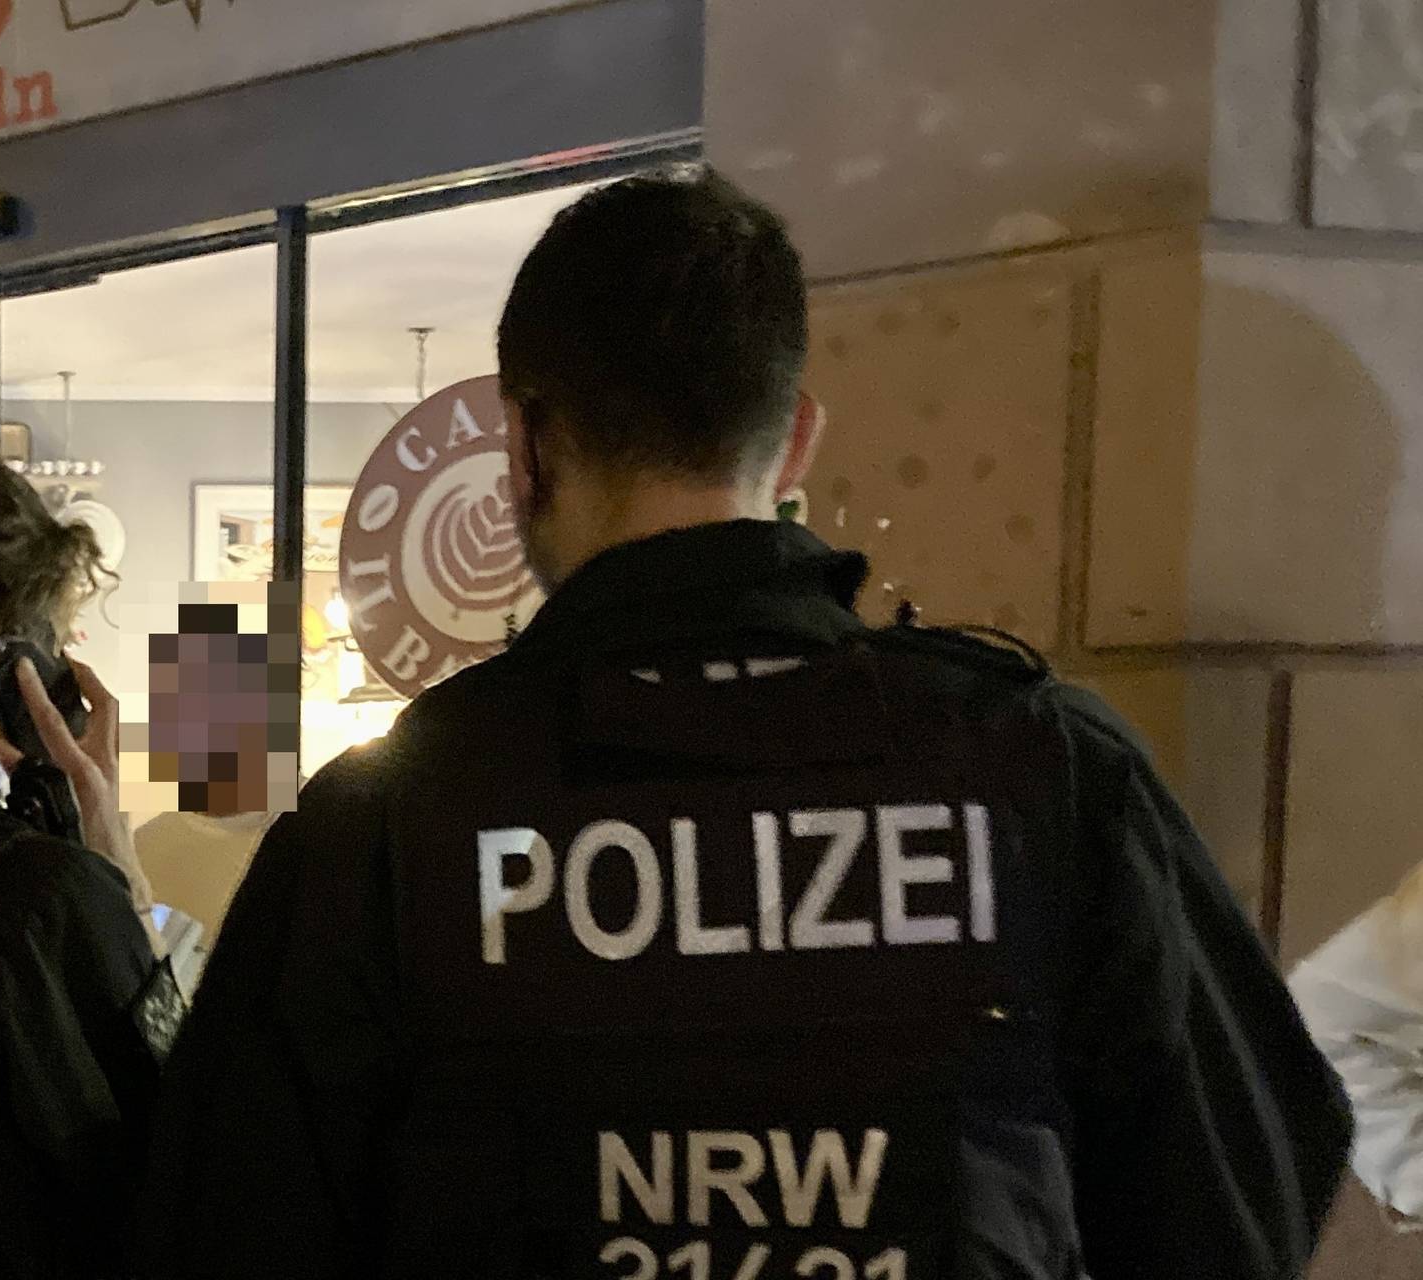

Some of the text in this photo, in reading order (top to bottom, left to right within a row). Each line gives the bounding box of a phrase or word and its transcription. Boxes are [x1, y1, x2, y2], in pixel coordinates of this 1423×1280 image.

[395, 398, 509, 472] CA
[477, 803, 998, 965] POLIZEI
[597, 1127, 888, 1229] NRW
